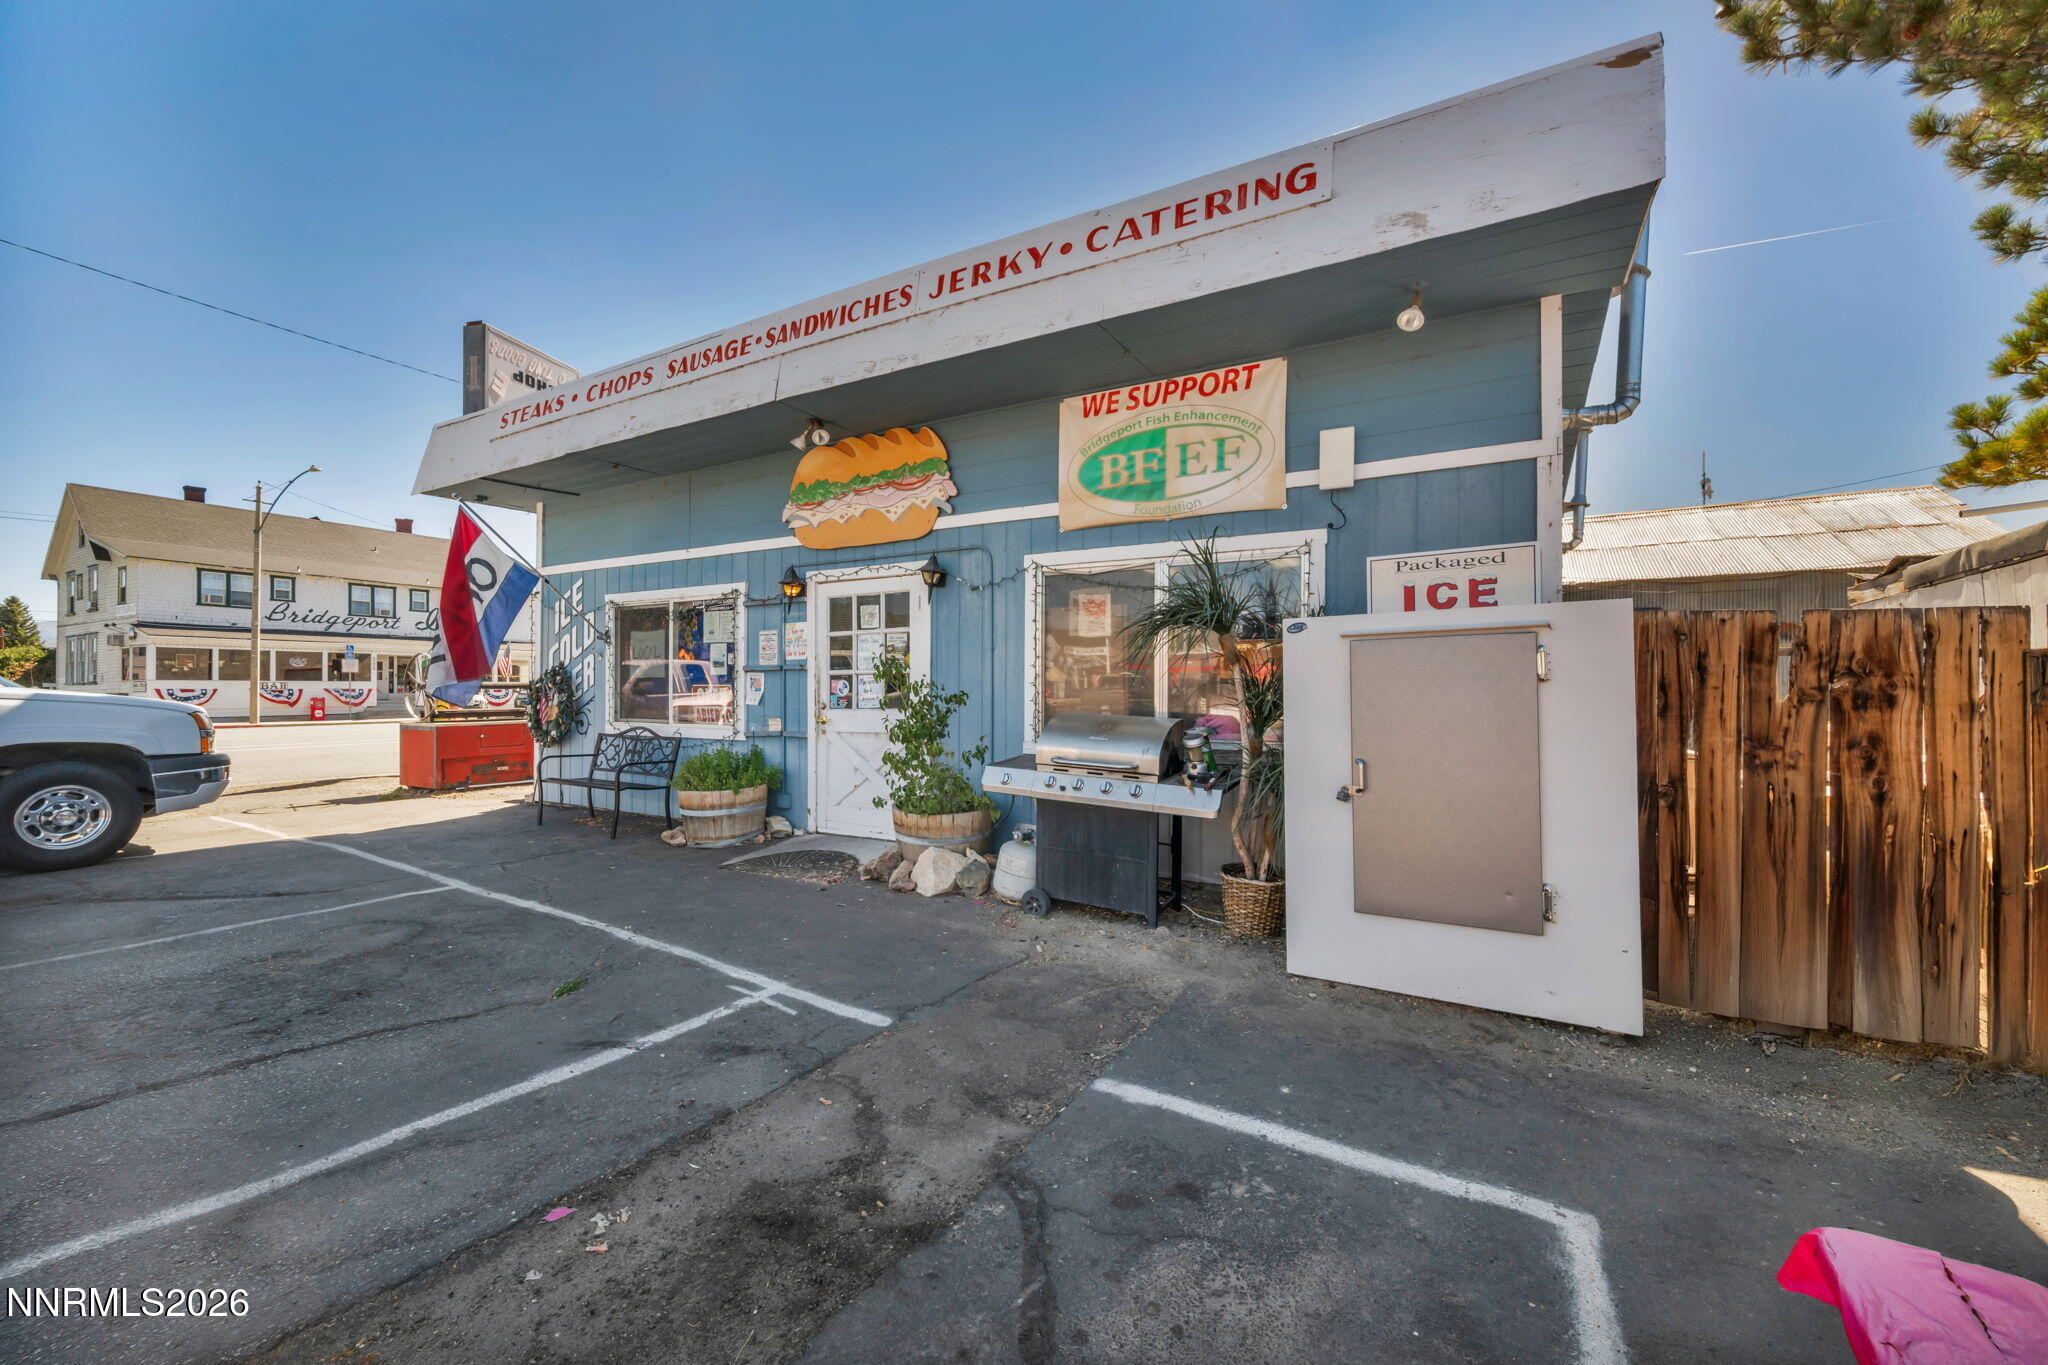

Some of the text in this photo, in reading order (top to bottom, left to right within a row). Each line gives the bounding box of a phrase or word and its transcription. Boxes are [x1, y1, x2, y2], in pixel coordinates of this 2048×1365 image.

[499, 162, 1317, 430] STEAKS CHOPS SAUSAGE SANDWICHES JERKY CATERING
[1082, 364, 1261, 418] WE SUPPORT
[1080, 410, 1263, 458] Bridgeport Fish Enhancement
[1133, 498, 1203, 516] Foundation
[1395, 551, 1507, 572] Packaged
[554, 576, 583, 635] ICE
[1403, 574, 1499, 612] ICE
[265, 602, 401, 632] Bridgeport
[548, 611, 595, 670] COLD
[260, 681, 287, 690] BAR
[572, 653, 595, 700] ER
